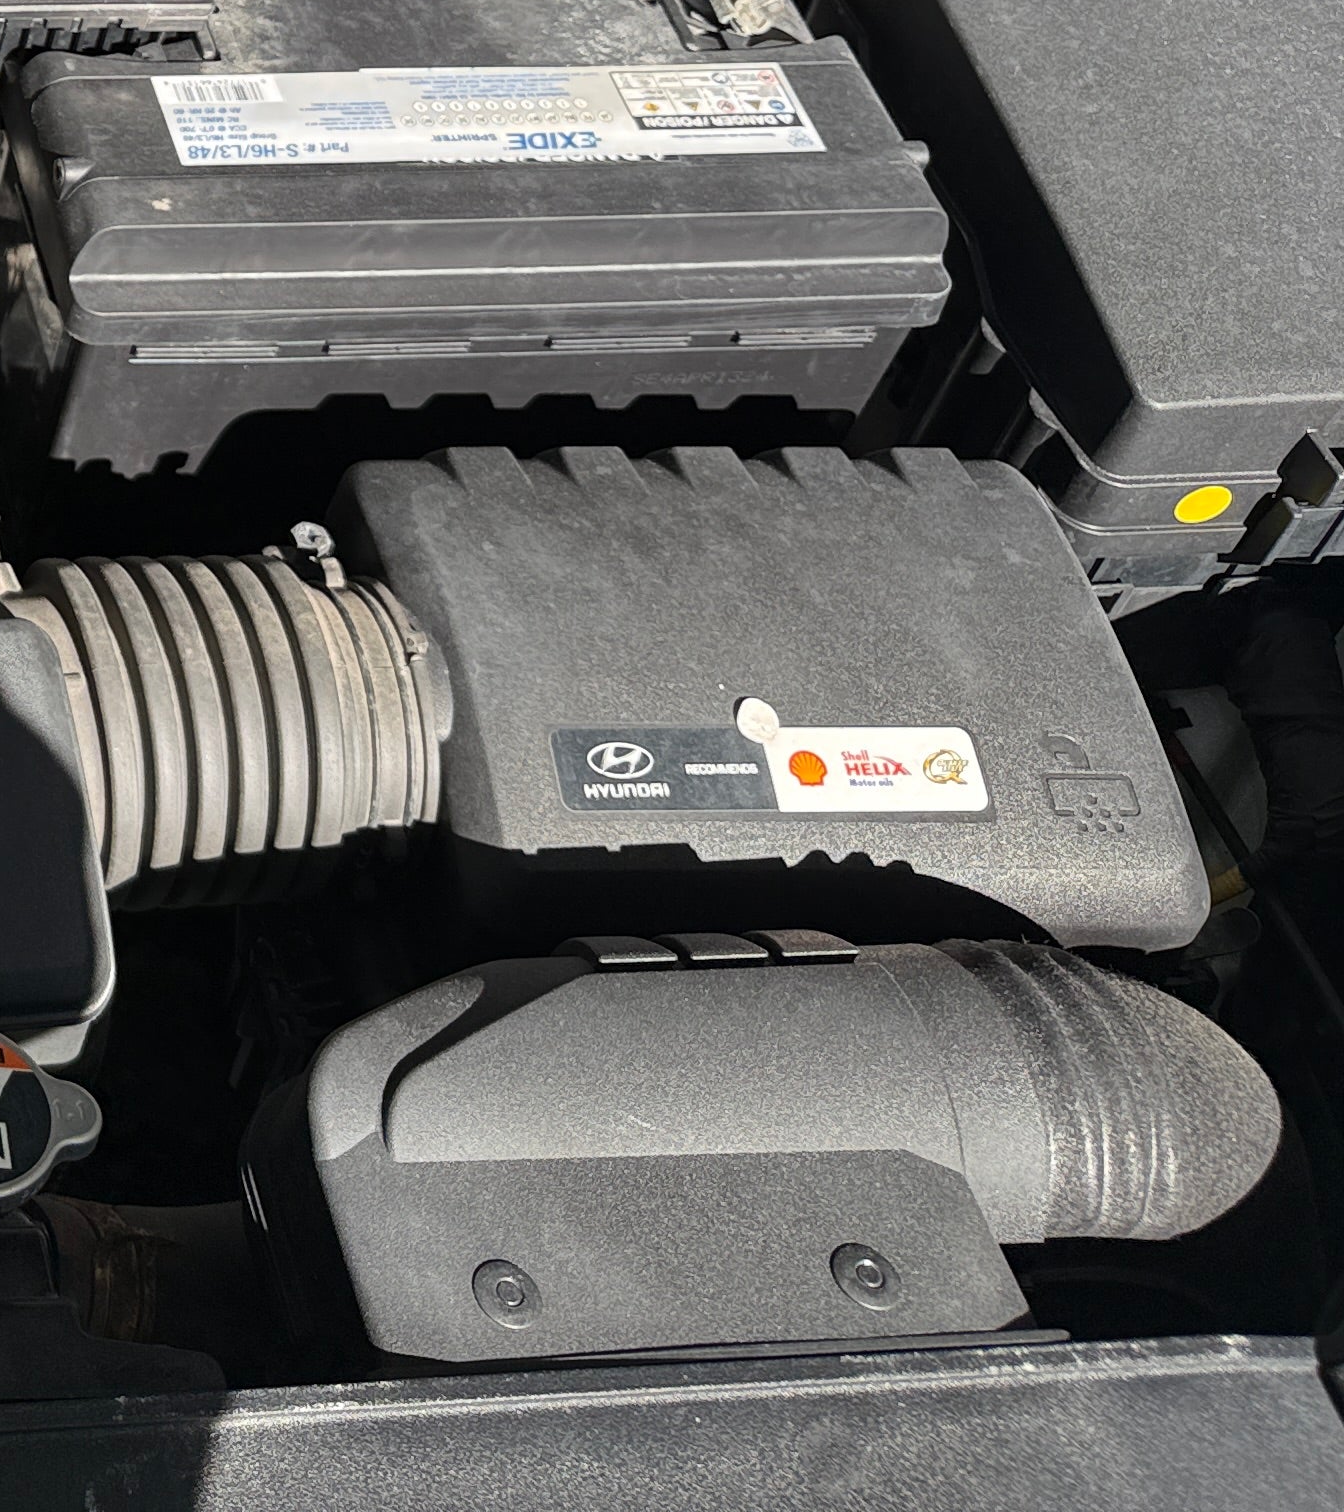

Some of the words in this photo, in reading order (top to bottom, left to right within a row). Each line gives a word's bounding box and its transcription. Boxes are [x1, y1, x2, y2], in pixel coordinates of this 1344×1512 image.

[432, 133, 499, 143] SPRINTER
[506, 131, 597, 150] EXIDE
[187, 142, 299, 159] S-H6/L3/48
[320, 142, 350, 153] Part
[840, 749, 870, 762] Shell
[844, 762, 909, 776] HELIX
[583, 782, 671, 800] HYUNDAI
